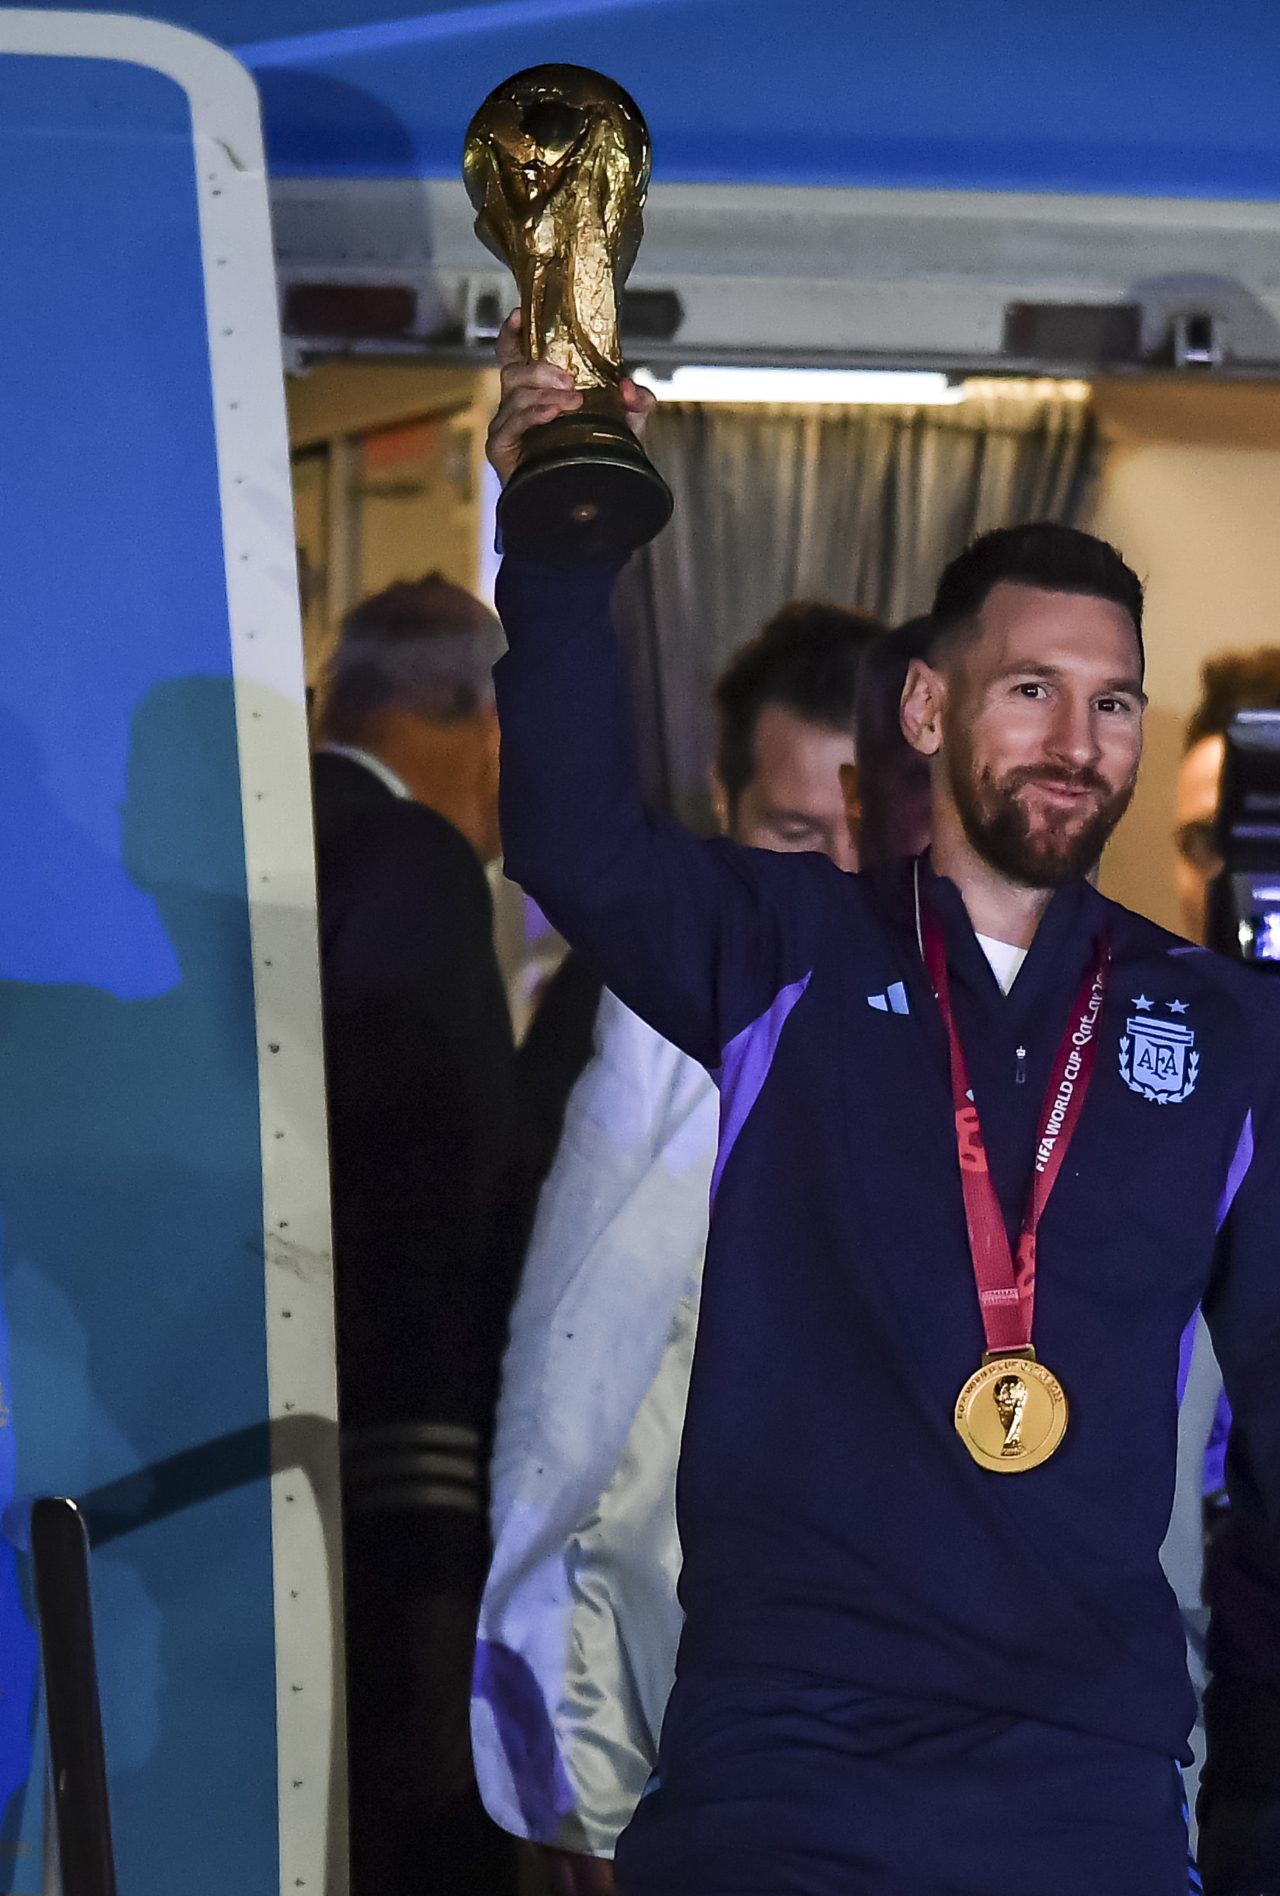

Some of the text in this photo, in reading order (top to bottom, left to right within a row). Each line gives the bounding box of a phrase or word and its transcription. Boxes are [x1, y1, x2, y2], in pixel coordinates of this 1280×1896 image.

[1064, 1051, 1082, 1080] CUP
[1137, 1039, 1179, 1080] AFA
[1045, 1081, 1074, 1136] WORLD
[1035, 1137, 1057, 1173] FIFA
